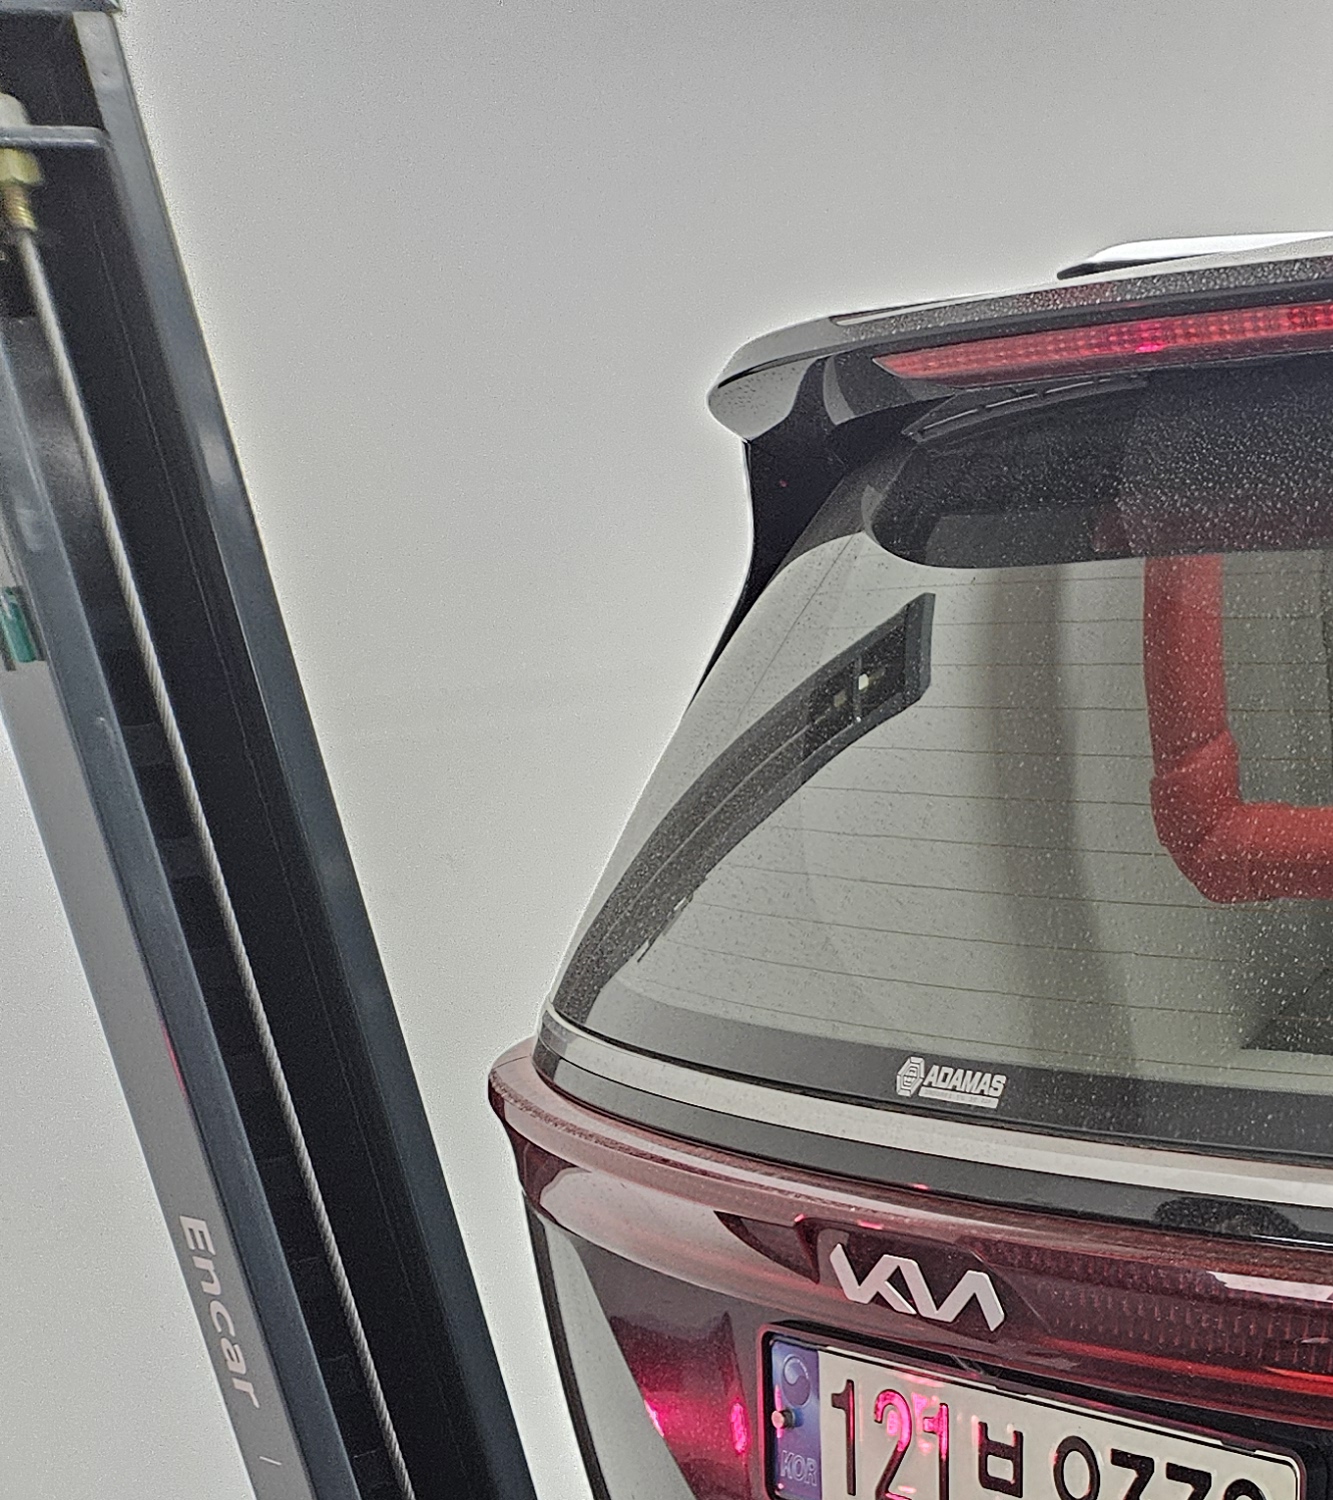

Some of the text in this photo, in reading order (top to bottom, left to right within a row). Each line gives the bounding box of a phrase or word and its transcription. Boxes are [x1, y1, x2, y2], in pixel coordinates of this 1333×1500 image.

[923, 1064, 1006, 1098] ADAMAS
[178, 1213, 260, 1410] Encar
[830, 1242, 1005, 1332] KIA
[780, 1448, 818, 1487] KOR
